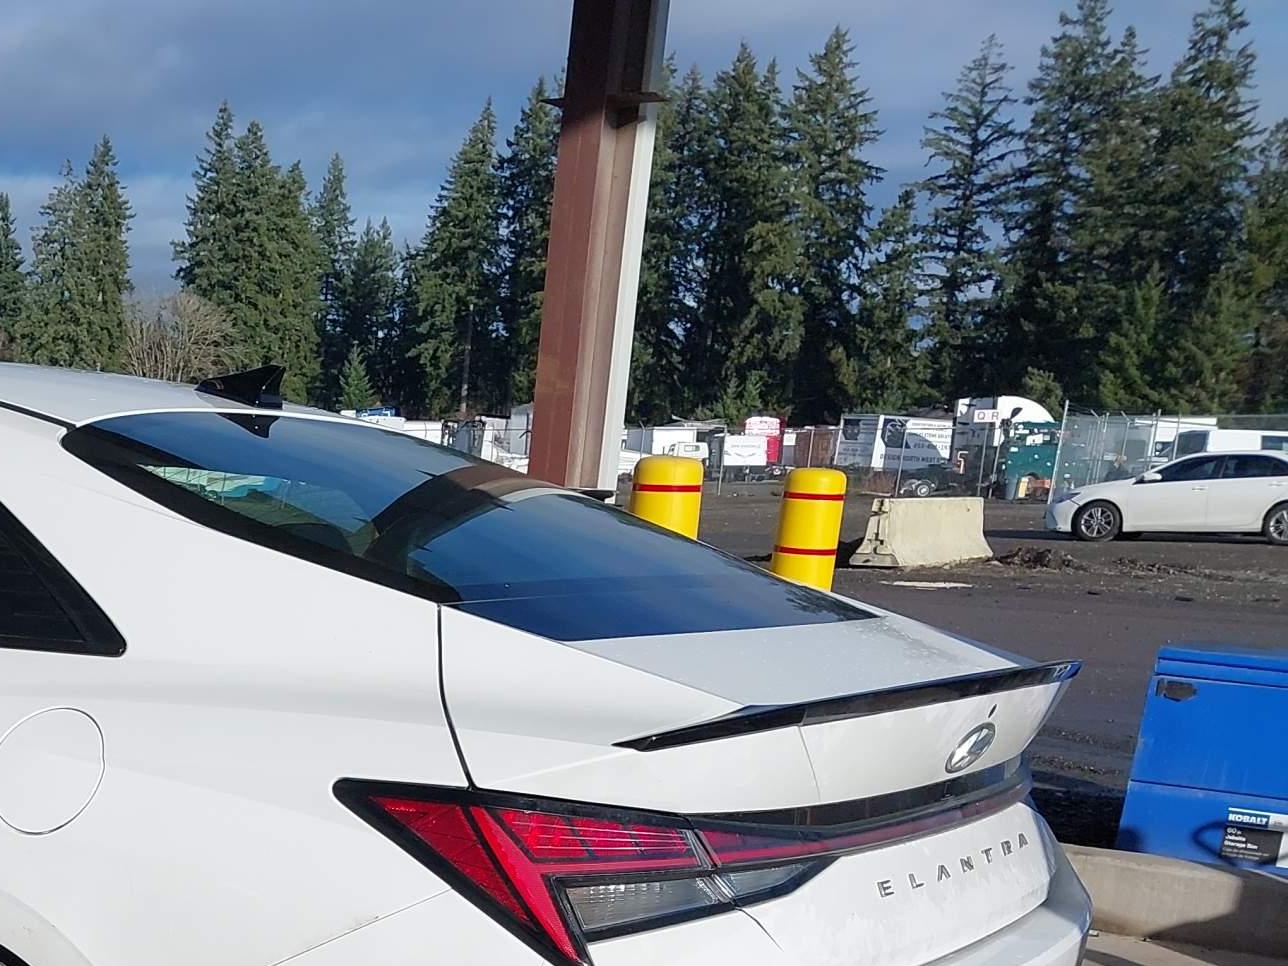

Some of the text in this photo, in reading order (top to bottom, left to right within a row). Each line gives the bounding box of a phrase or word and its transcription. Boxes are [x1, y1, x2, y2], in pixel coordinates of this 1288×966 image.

[977, 412, 999, 420] Q R
[1228, 813, 1268, 825] KOBALT
[877, 832, 1029, 898] ELANTRA
